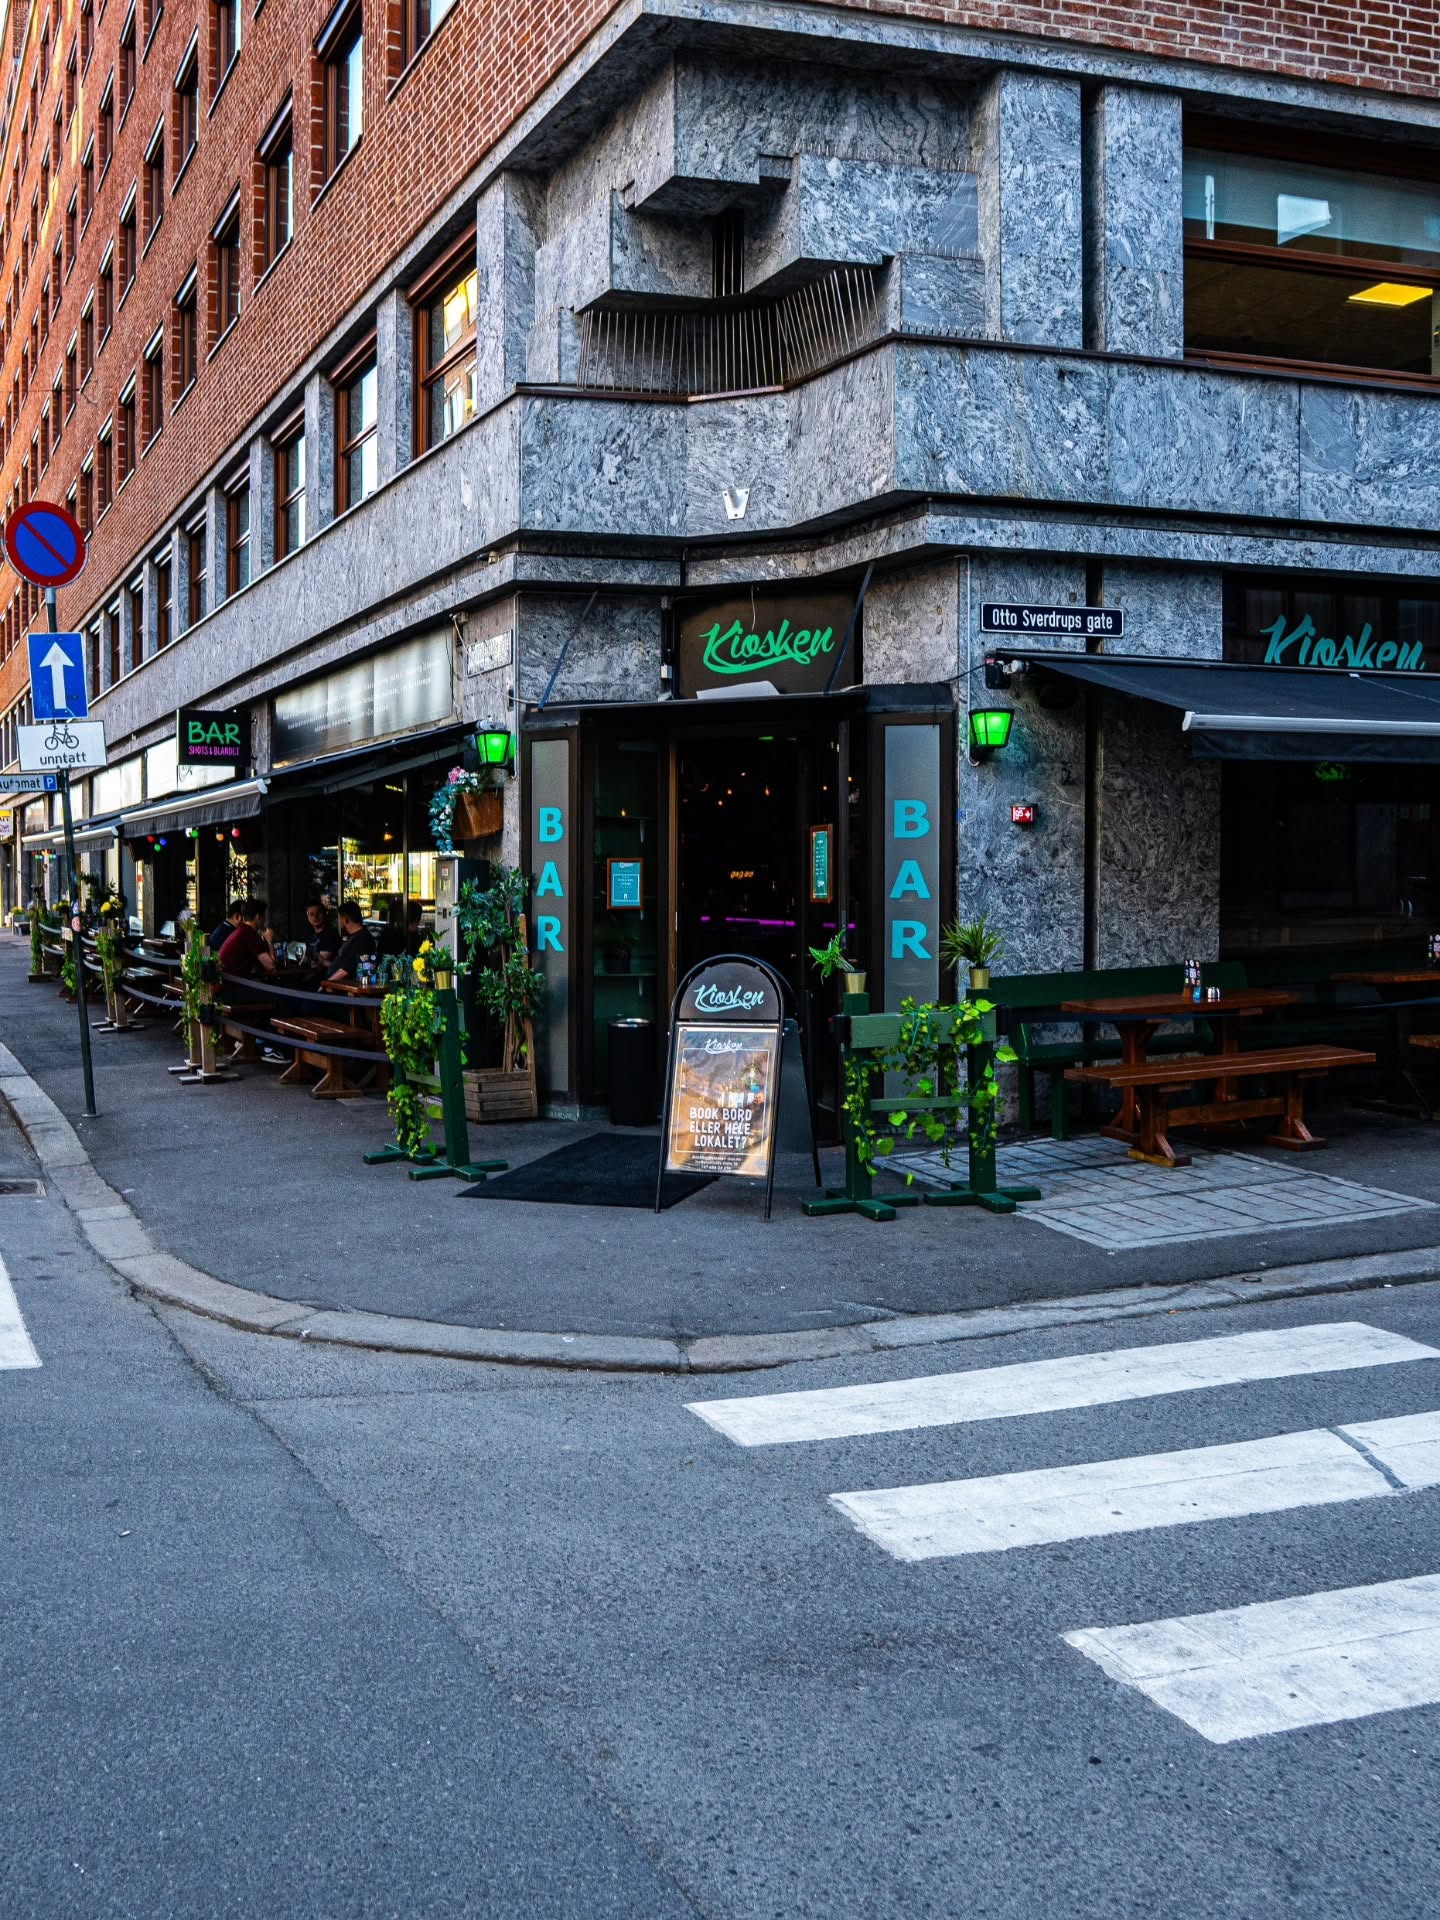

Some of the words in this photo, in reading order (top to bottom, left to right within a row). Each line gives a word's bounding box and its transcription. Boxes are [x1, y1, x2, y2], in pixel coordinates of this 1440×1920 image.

[992, 608, 1018, 626] Otto
[1022, 609, 1082, 632] Sverdrups
[1086, 612, 1113, 633] gate
[699, 619, 835, 674] Kiosken
[1259, 613, 1426, 671] Kiosken
[188, 720, 241, 745] BAR
[39, 752, 87, 766] unntatt
[536, 807, 565, 952] BAR
[889, 799, 933, 960] BAR
[693, 983, 765, 1013] Kiosken
[704, 1038, 744, 1055] Kiosken
[689, 1107, 719, 1120] BOOK
[722, 1107, 753, 1121] BORD
[689, 1120, 720, 1134] ELLER
[724, 1121, 752, 1136] HELE
[694, 1134, 748, 1149] LOKALET?
